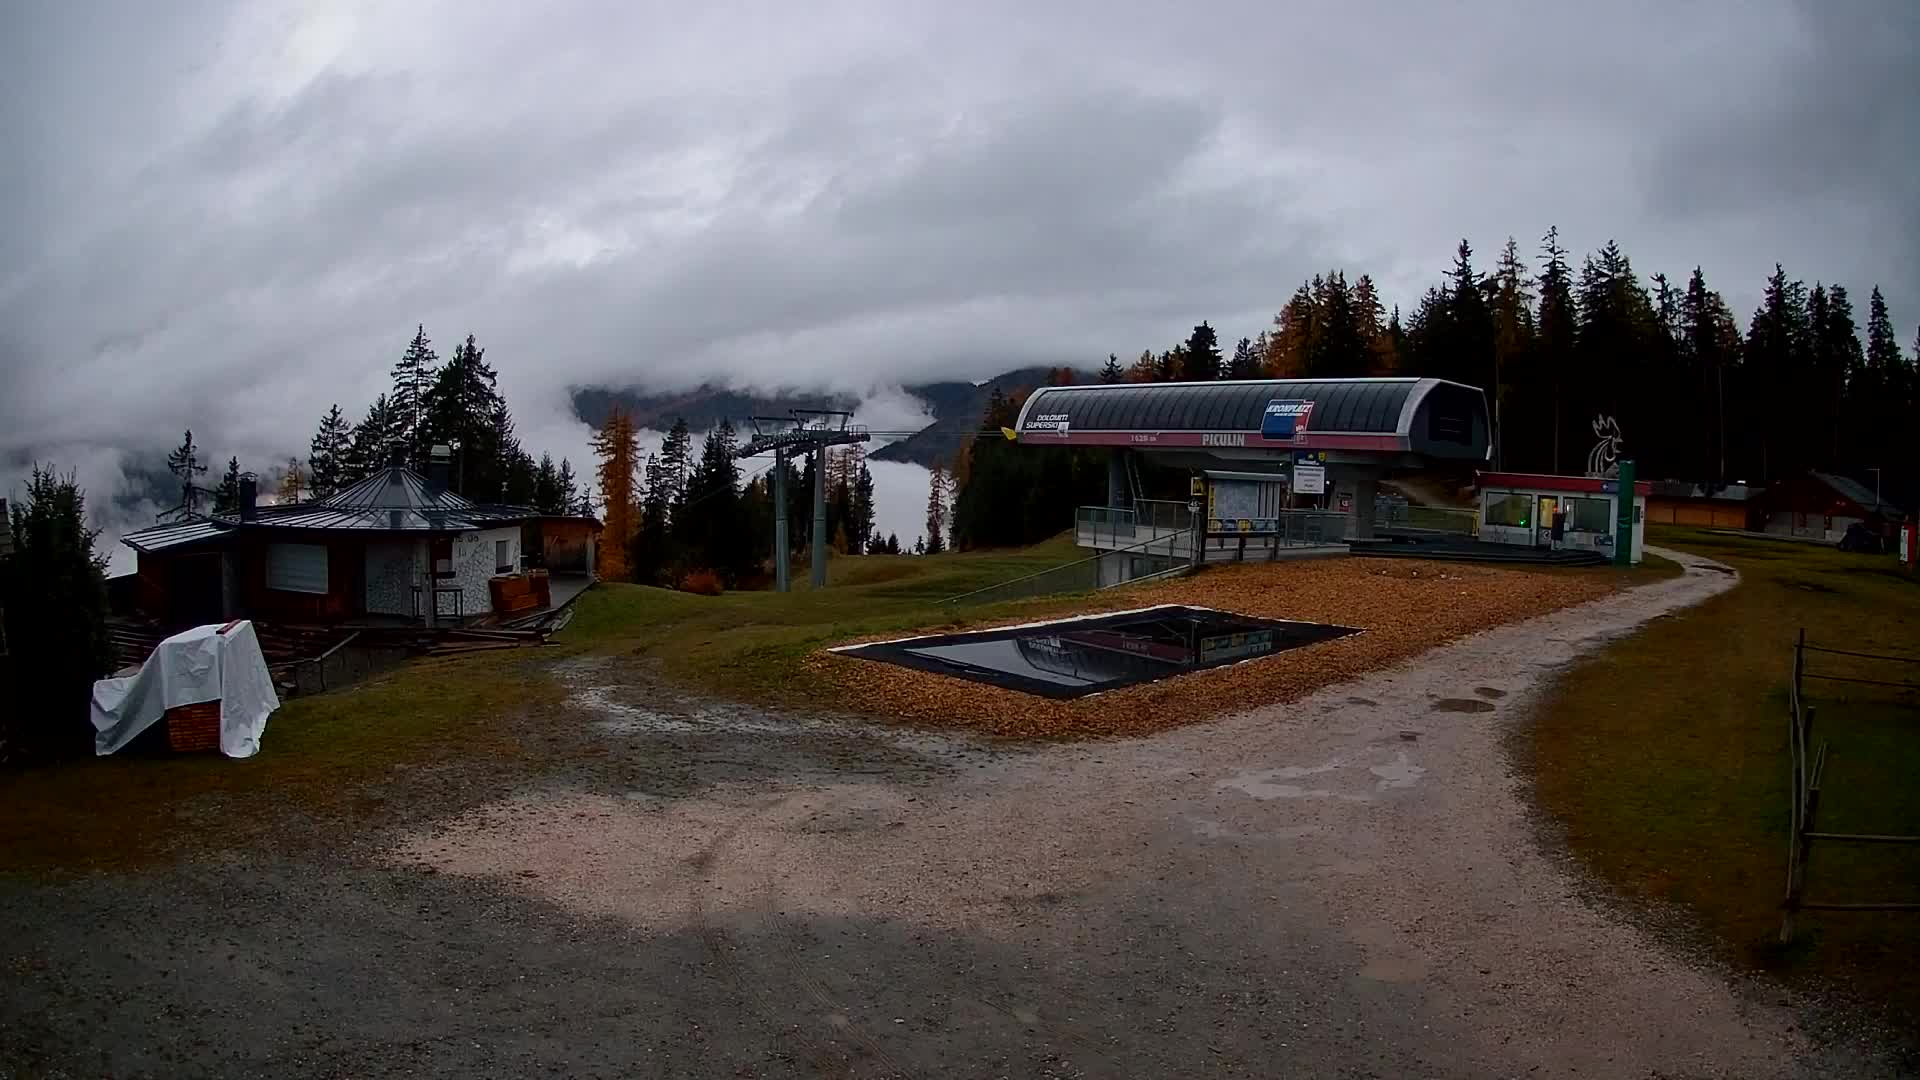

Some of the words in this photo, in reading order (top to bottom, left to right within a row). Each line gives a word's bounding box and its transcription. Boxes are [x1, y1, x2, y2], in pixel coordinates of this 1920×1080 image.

[1266, 404, 1312, 413] KRONPLATZ
[1026, 421, 1058, 429] SUPERSKI
[1202, 433, 1245, 447] PICULIN
